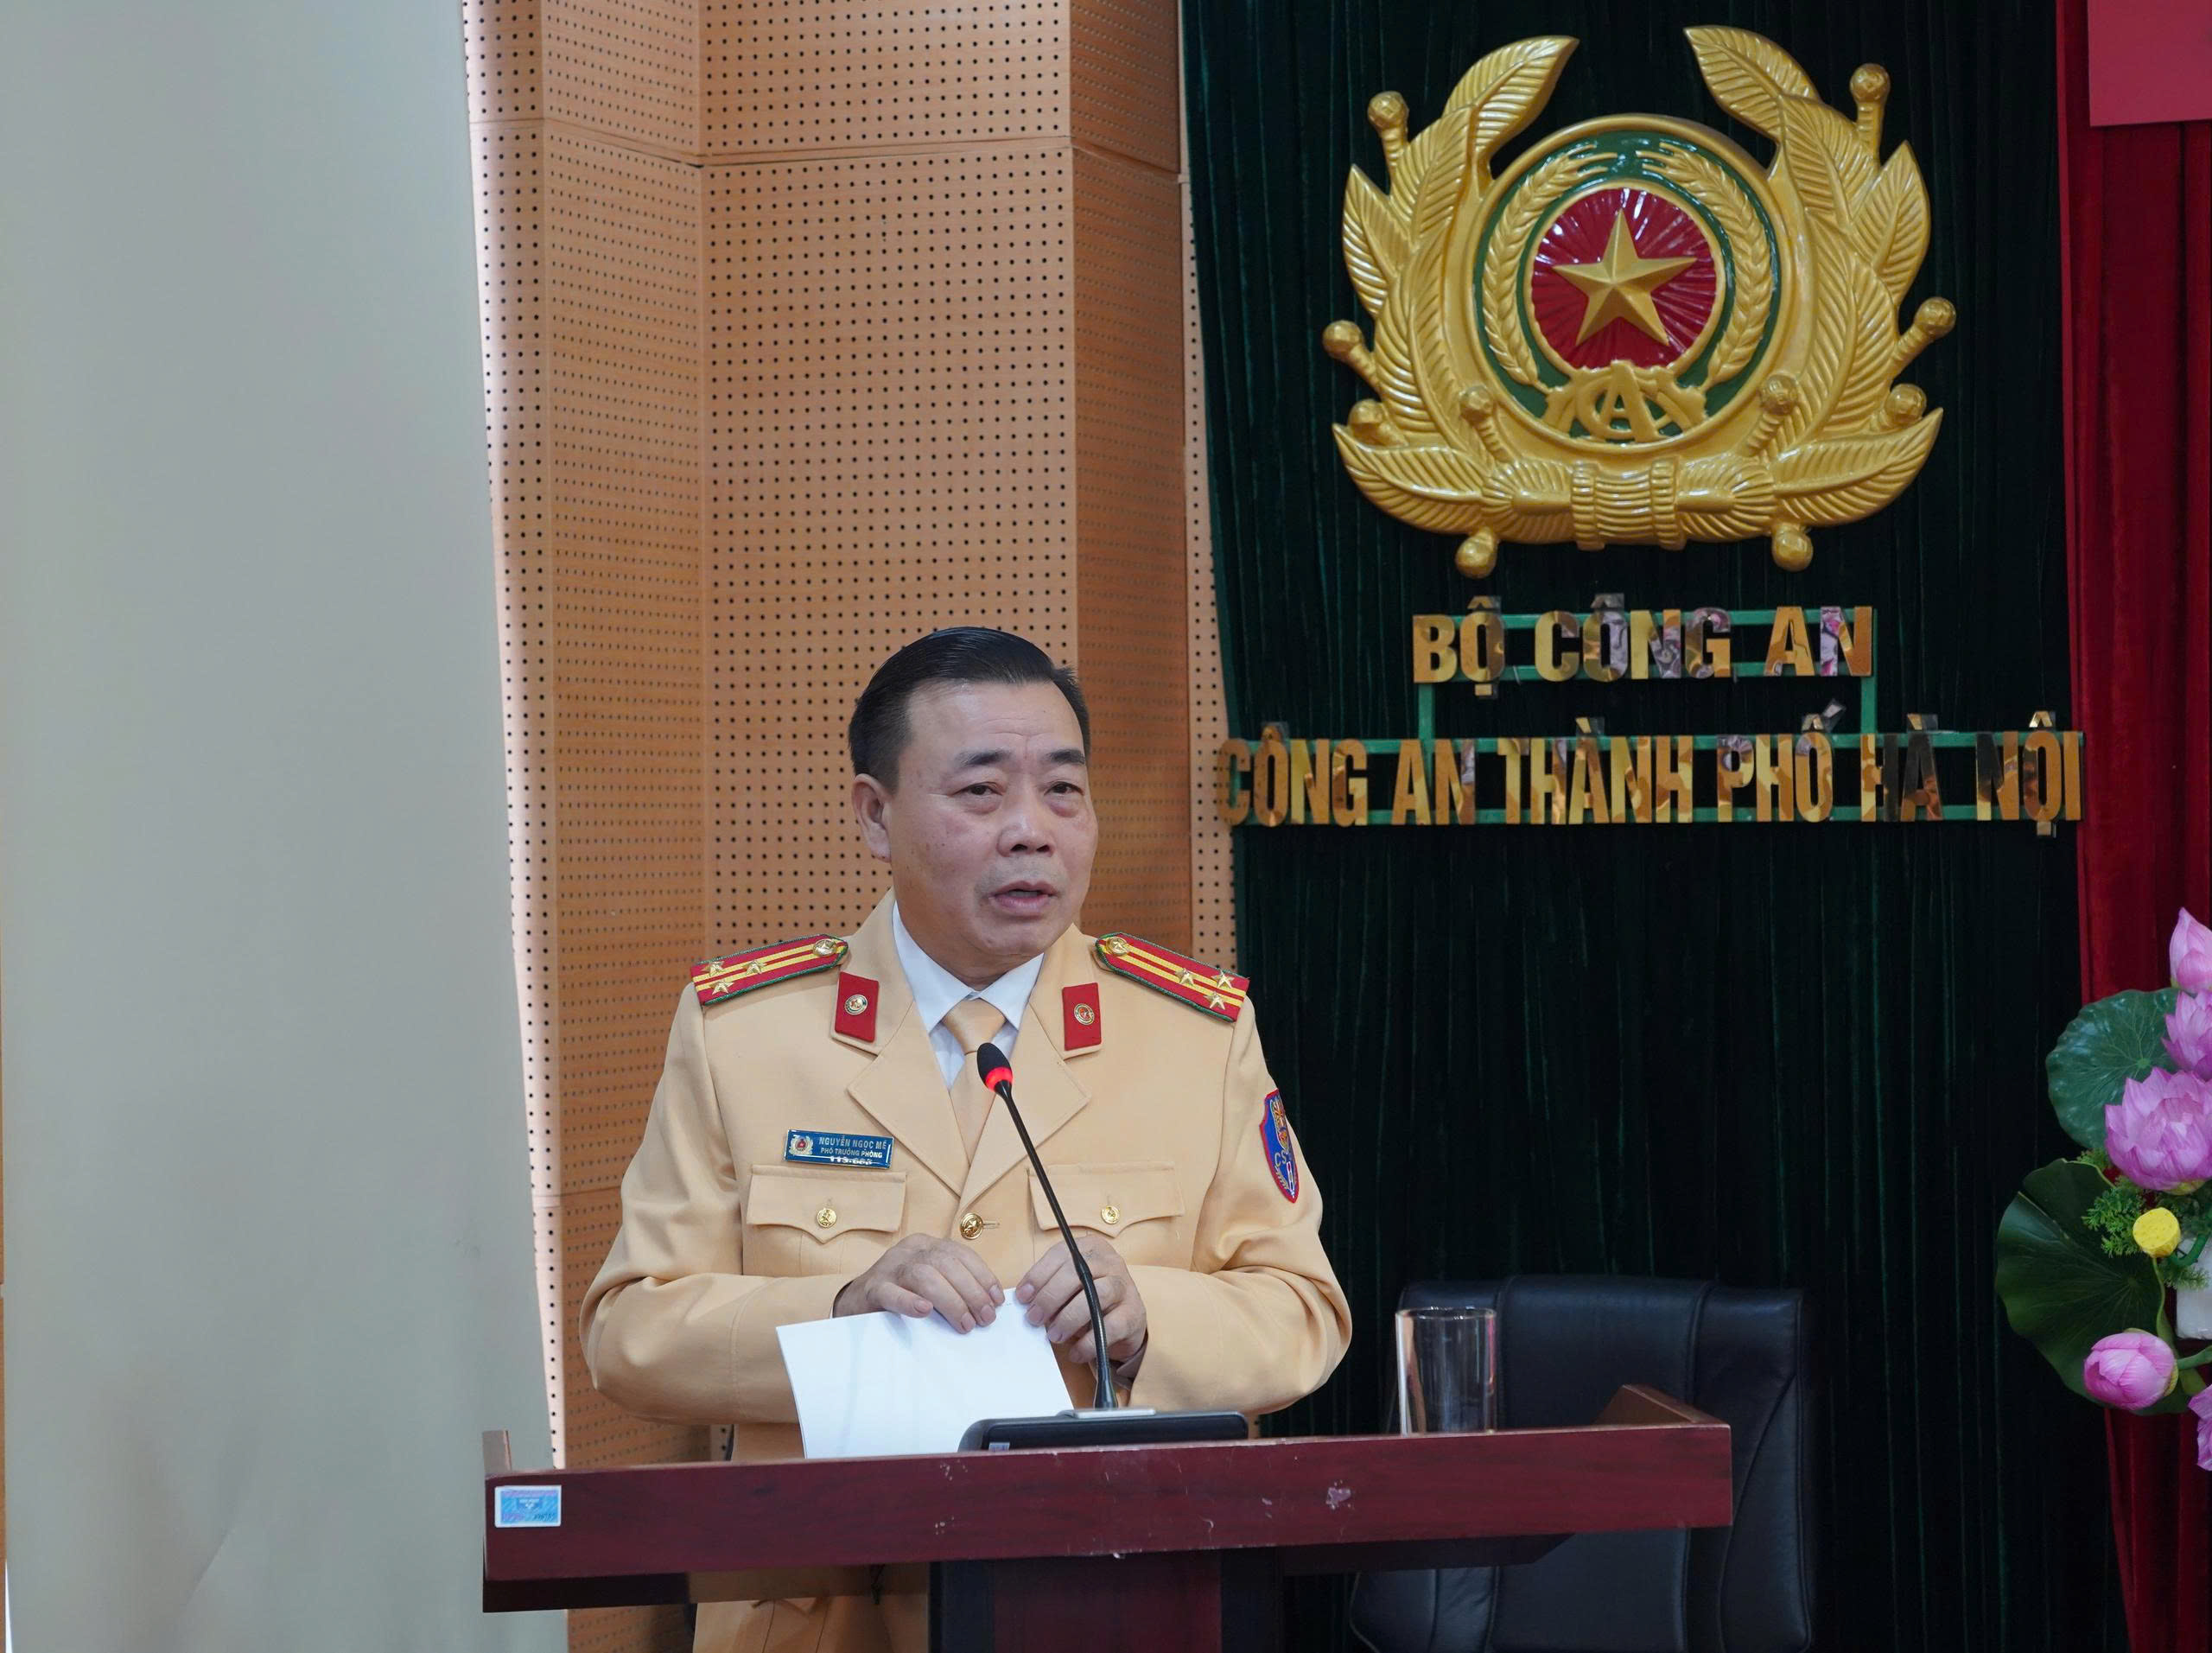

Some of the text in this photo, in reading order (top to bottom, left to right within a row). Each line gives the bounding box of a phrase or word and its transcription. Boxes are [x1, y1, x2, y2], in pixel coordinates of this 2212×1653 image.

[1413, 594, 1872, 696] BỘ CÔNG AN
[1216, 702, 2082, 836] CÔNG AN THÀNH PHỐ HÀ NỘI
